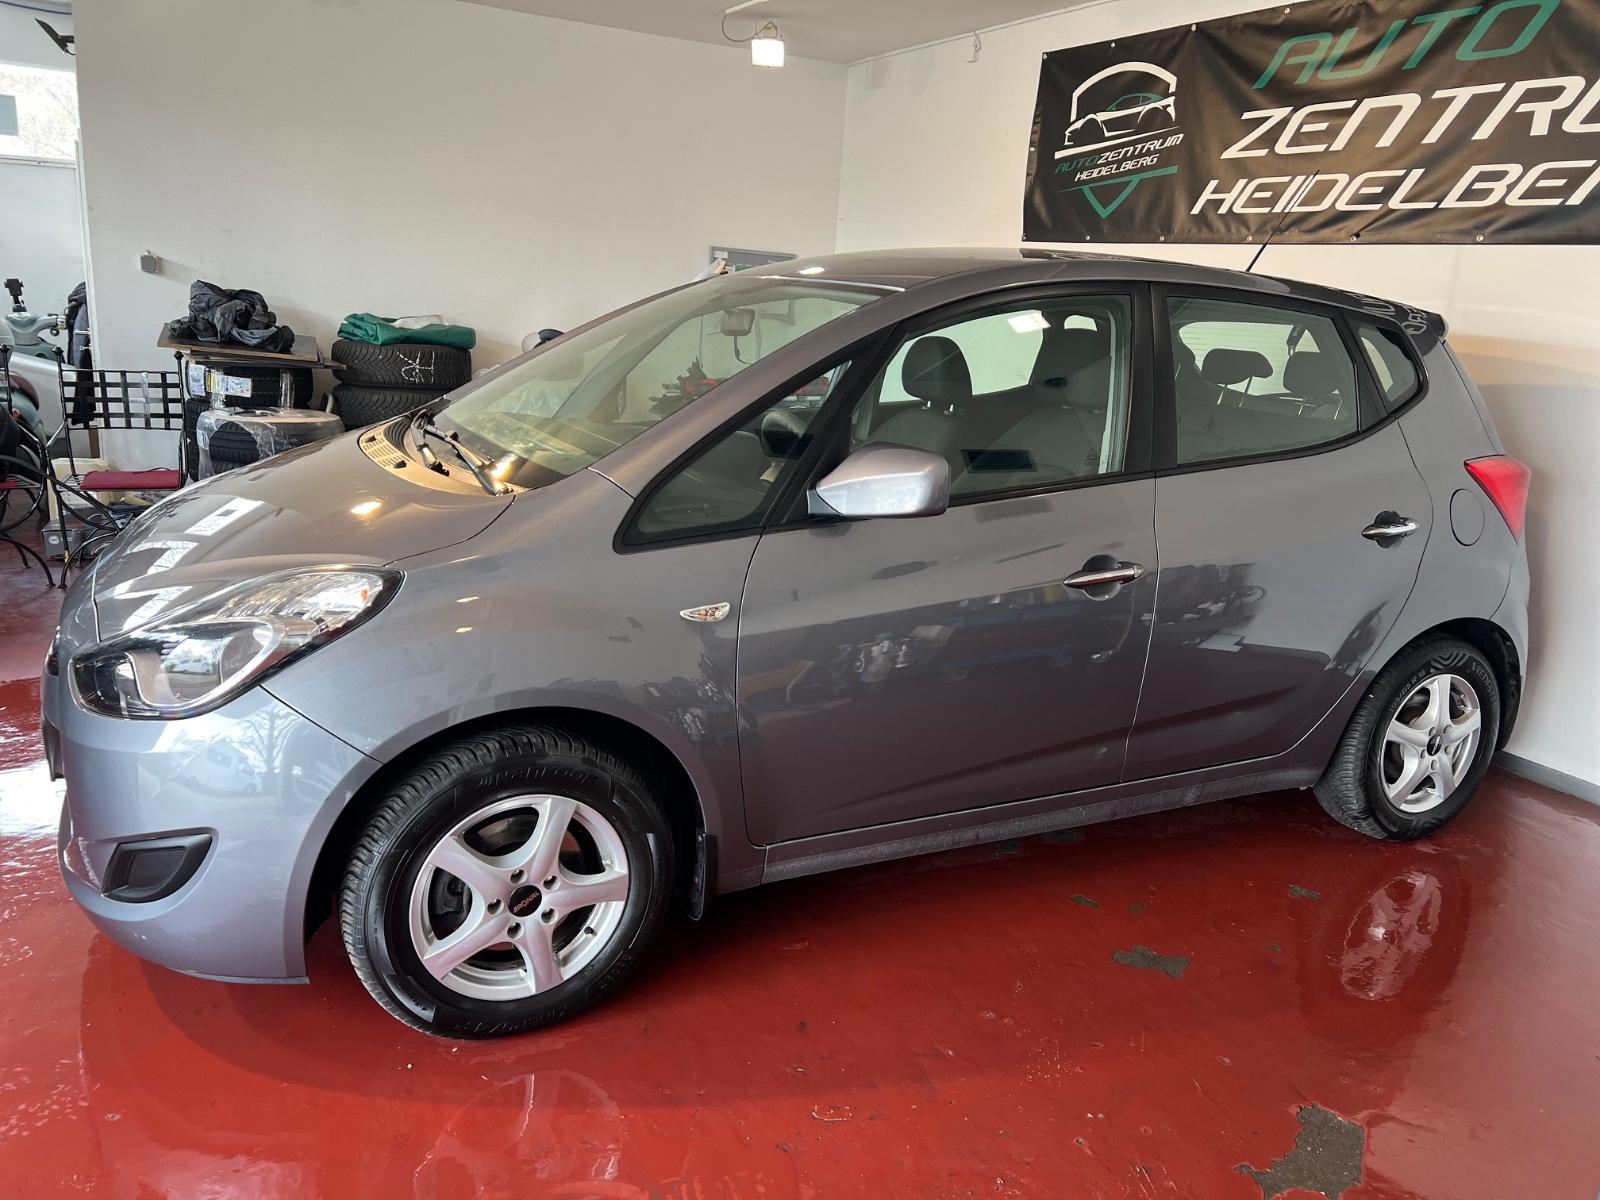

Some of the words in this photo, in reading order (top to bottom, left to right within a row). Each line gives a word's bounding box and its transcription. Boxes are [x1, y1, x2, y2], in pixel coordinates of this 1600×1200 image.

[1251, 0, 1560, 89] AUTO
[1055, 133, 1184, 174] AUTOZENTRUM
[1075, 154, 1160, 181] HEIDELBERG
